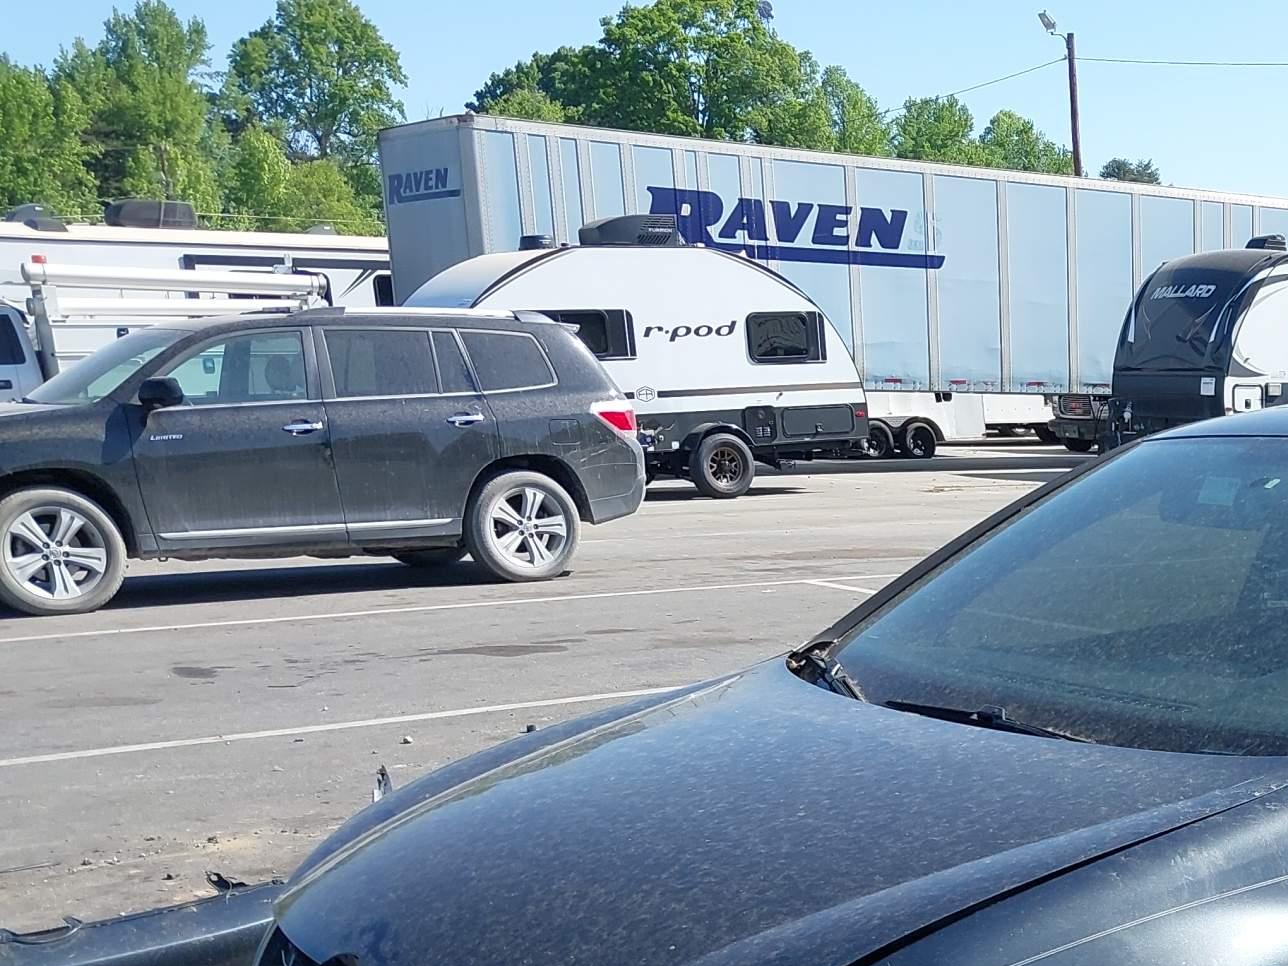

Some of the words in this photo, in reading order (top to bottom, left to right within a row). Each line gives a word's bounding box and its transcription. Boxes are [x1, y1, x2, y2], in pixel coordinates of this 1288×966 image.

[387, 167, 457, 206] RAVEN
[646, 186, 935, 266] RAVEN
[1150, 284, 1217, 300] MALLARD
